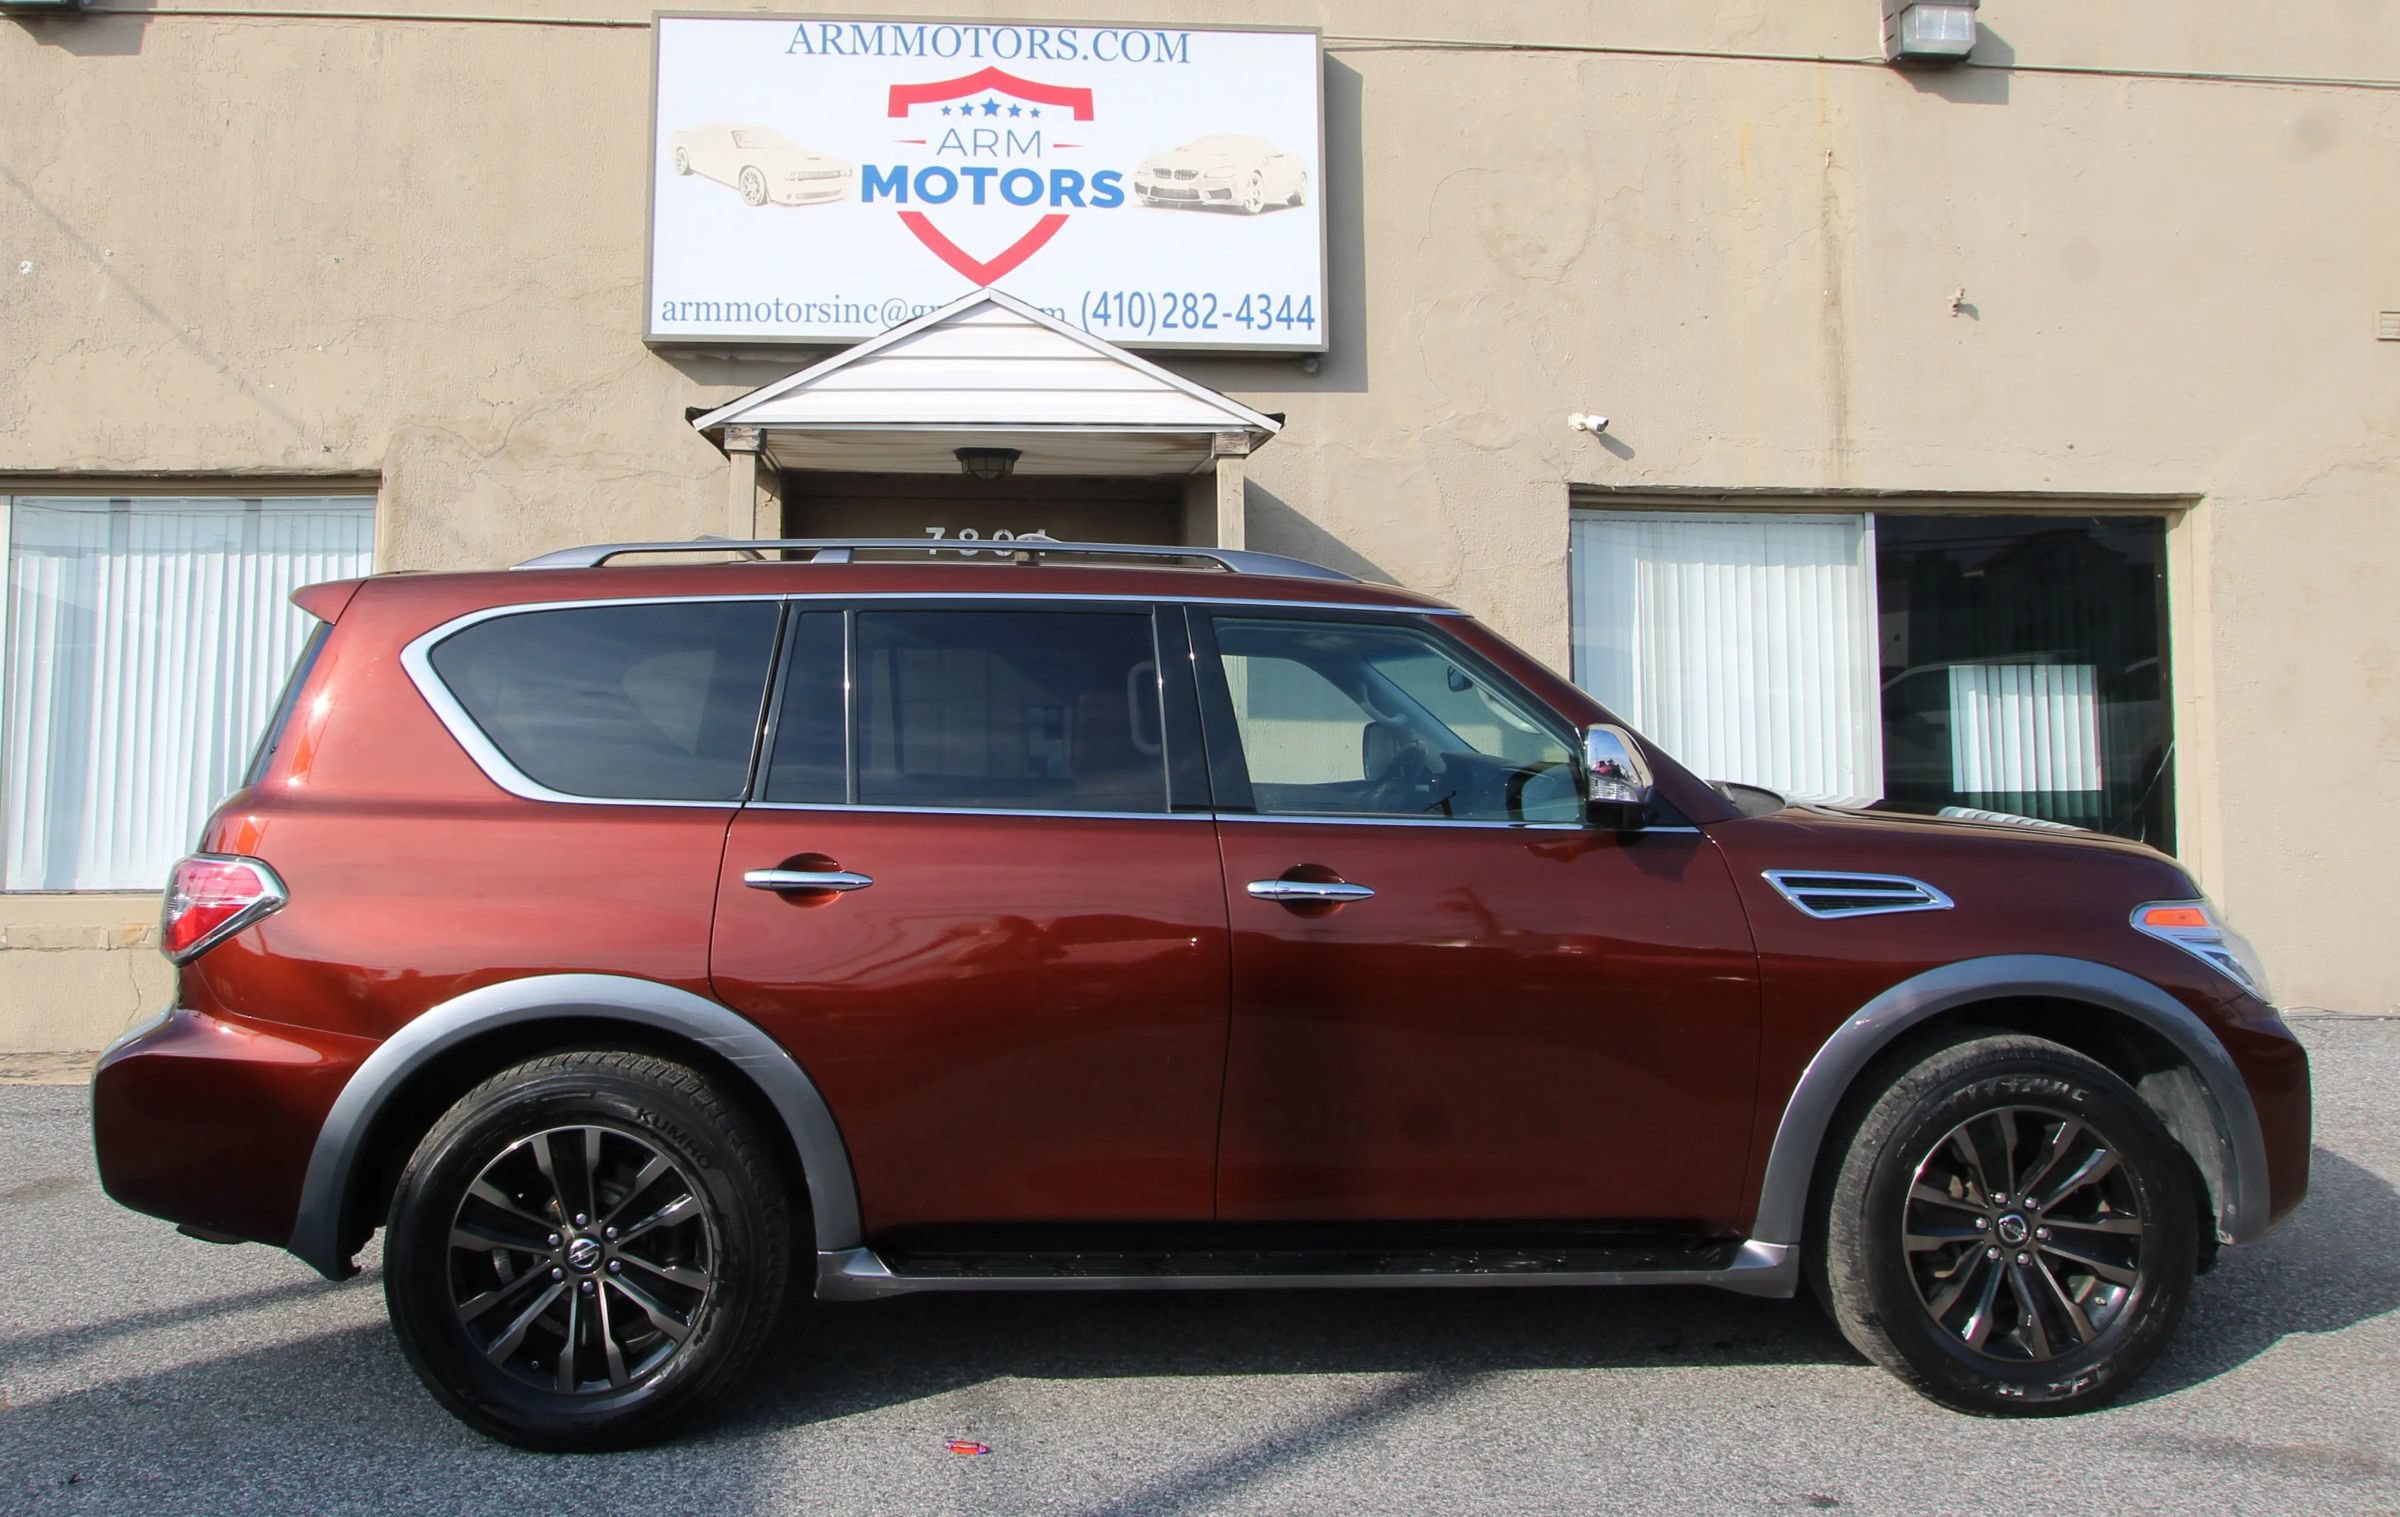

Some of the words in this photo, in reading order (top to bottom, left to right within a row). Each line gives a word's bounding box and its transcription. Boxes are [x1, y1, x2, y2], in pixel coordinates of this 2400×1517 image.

[785, 23, 1191, 64] ARMMOTORS.COM
[936, 128, 1042, 158] ARM
[861, 164, 1126, 209] MOTORS
[1081, 290, 1316, 337] (410)282-4344
[637, 1108, 711, 1169] KUMHO
